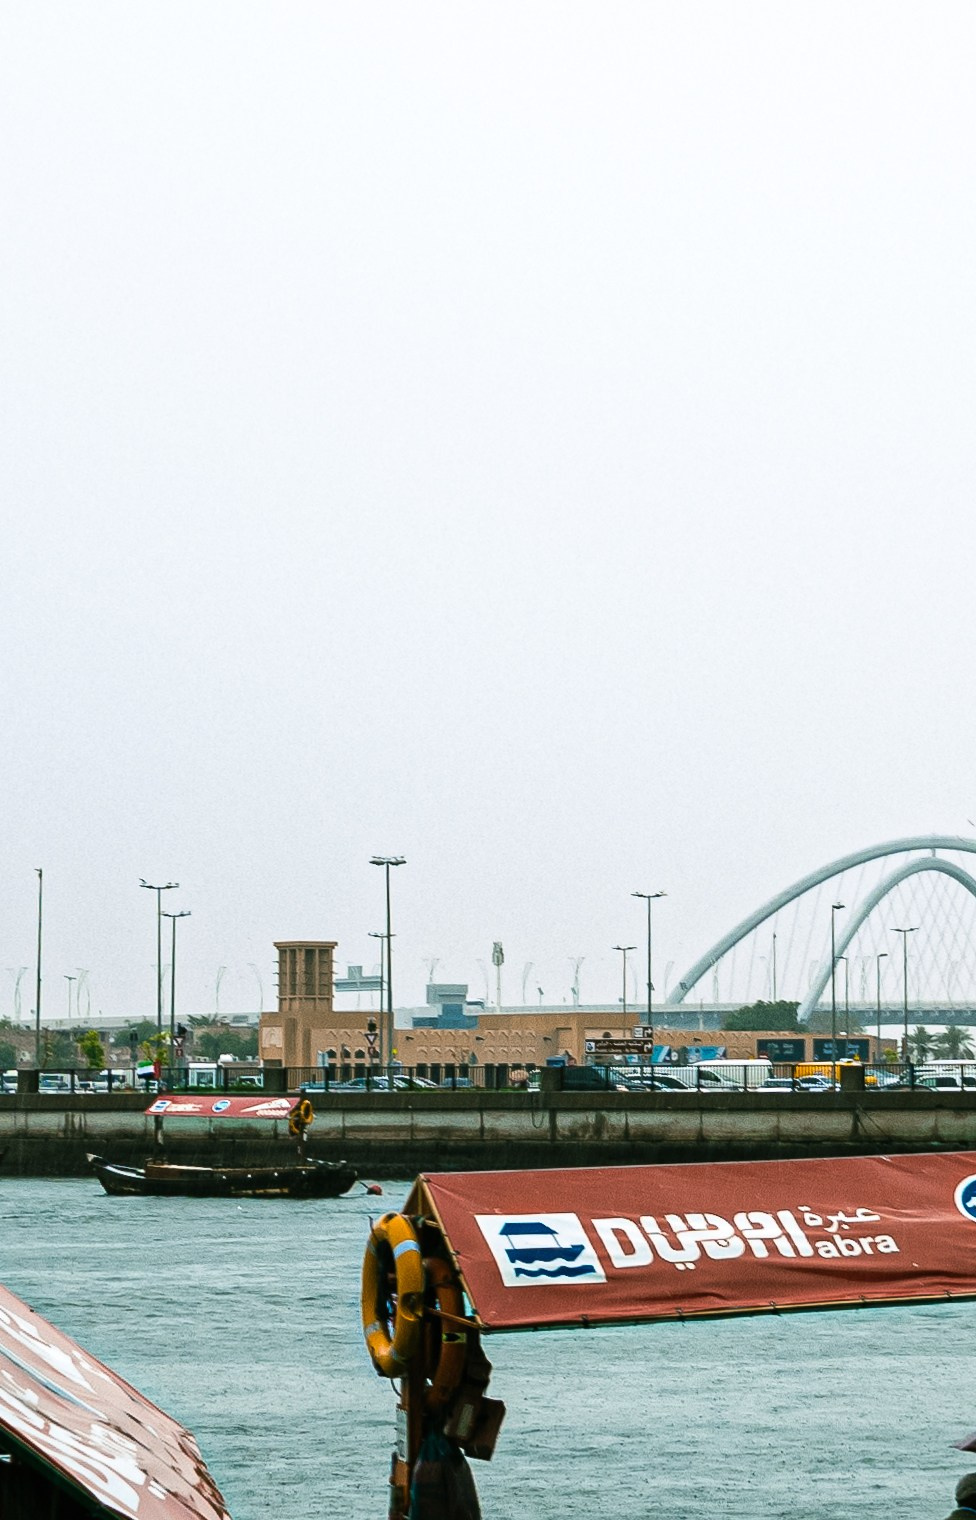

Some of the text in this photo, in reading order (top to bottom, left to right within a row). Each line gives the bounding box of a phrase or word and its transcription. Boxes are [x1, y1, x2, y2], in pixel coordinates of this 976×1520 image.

[797, 1205, 881, 1233] عبرة
[591, 1209, 815, 1271] DUBAI
[814, 1233, 900, 1259] abra
